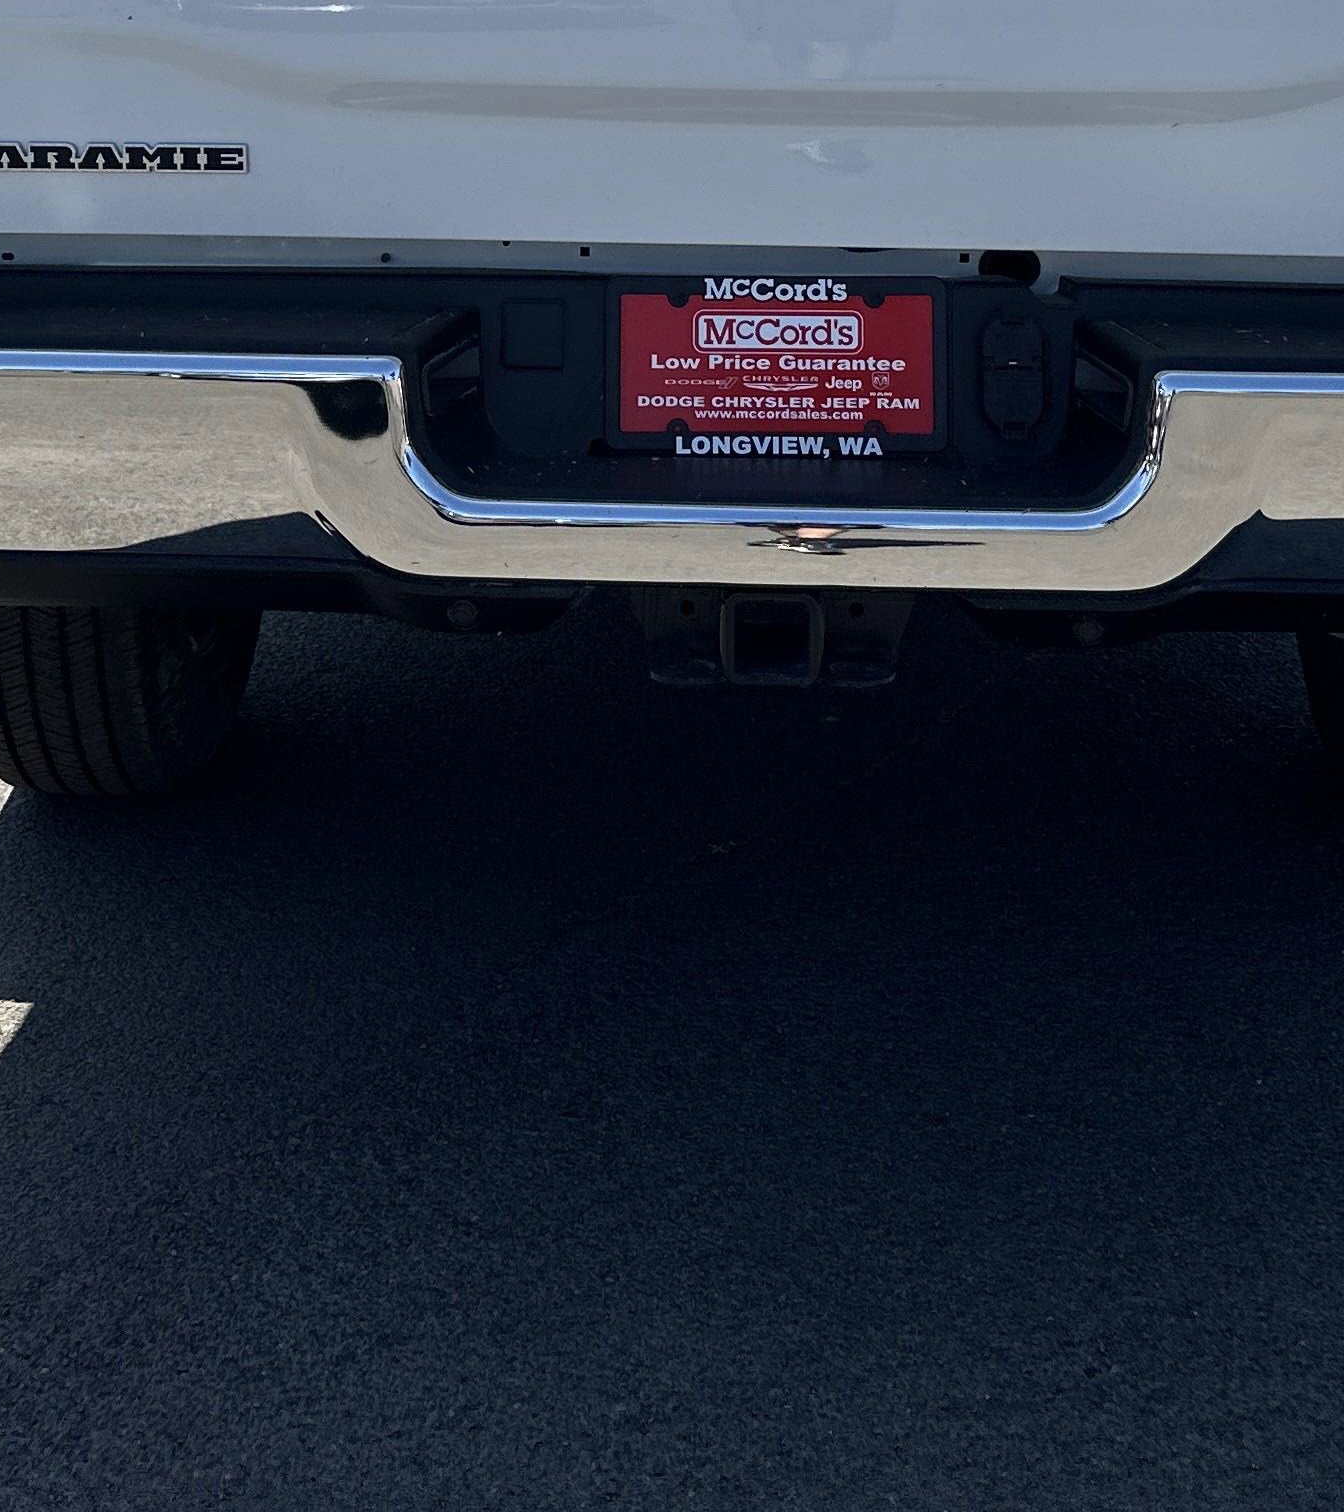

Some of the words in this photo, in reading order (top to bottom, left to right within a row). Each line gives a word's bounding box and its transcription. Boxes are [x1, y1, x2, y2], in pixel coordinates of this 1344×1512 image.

[704, 278, 848, 301] McCord's
[703, 318, 854, 346] McCord's
[650, 354, 701, 369] Low
[708, 355, 771, 370] Price
[778, 355, 906, 371] Guarantee
[742, 374, 819, 383] CHRYSLER
[825, 376, 863, 391] Jeep
[637, 395, 705, 407] DODGE
[711, 396, 815, 408] CHRYSLER
[821, 397, 871, 409] JEEP
[876, 398, 920, 410] RAM
[694, 409, 864, 420] www.mccordsales.com
[675, 436, 831, 459] LONGVIEW,
[838, 437, 883, 456] WA
